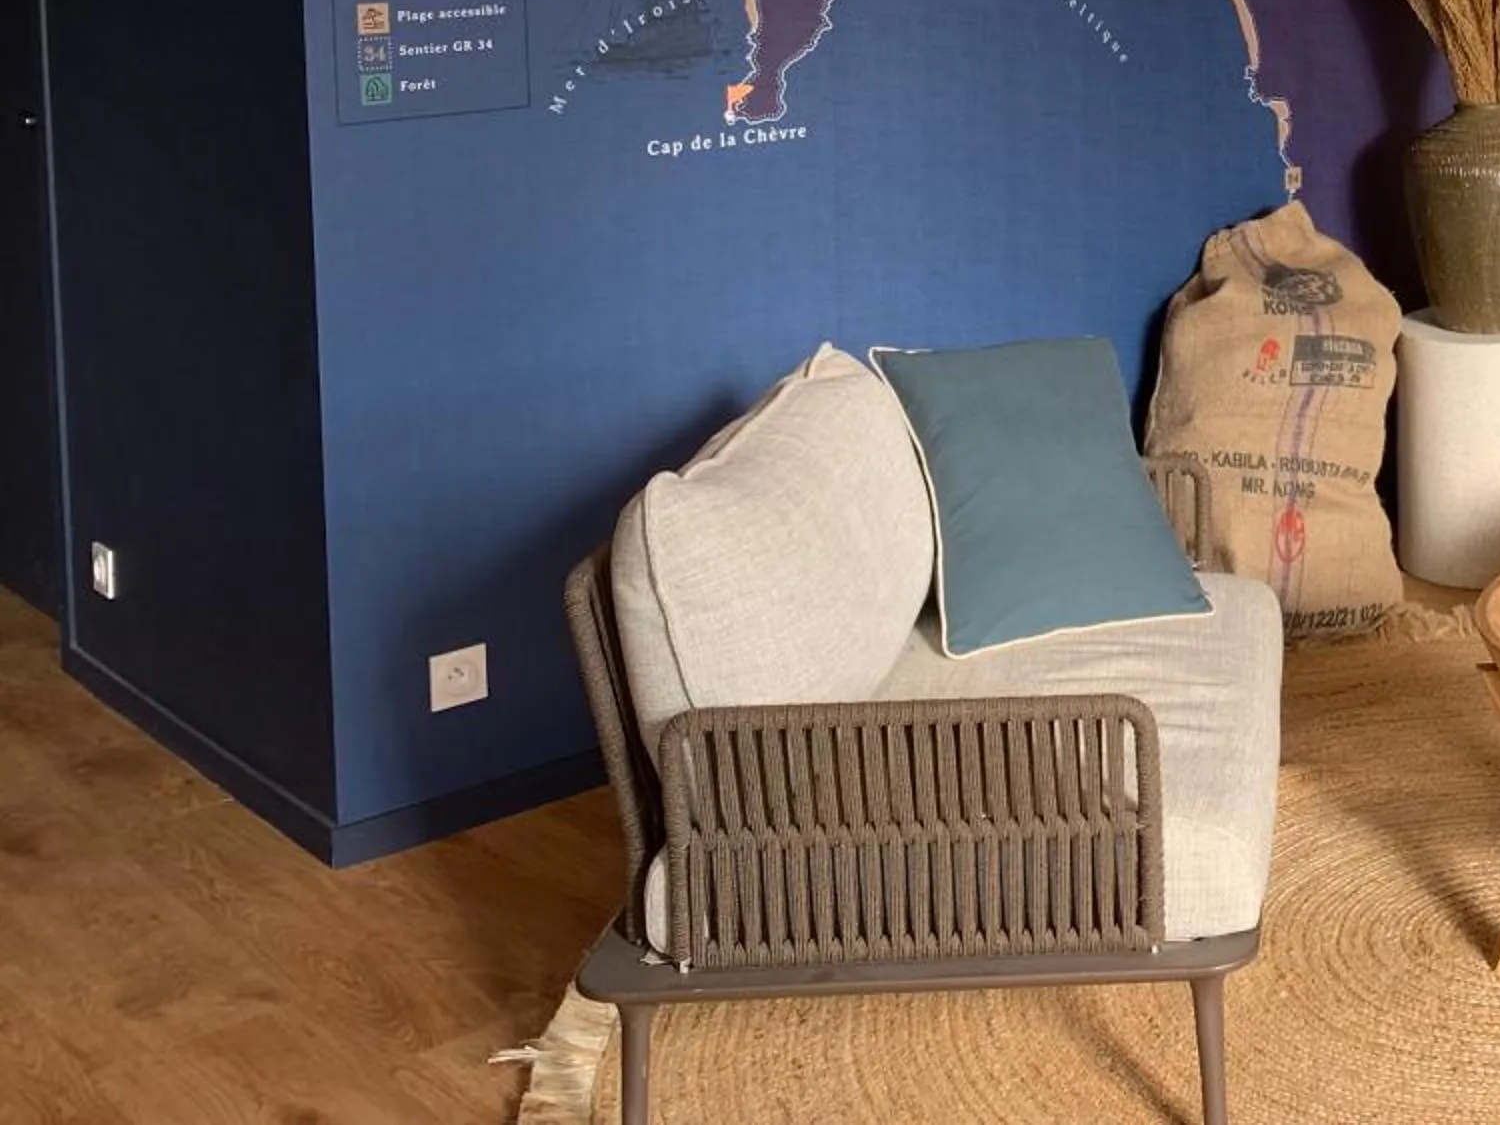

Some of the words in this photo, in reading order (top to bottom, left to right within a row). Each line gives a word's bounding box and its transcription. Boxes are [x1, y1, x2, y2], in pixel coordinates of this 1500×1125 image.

[397, 10, 434, 23] Plage
[437, 3, 507, 20] accessible
[399, 42, 449, 57] Sentier
[453, 39, 473, 53] GR
[477, 38, 493, 50] 34
[400, 78, 436, 92] Forêt
[548, 65, 586, 115] Mer
[647, 140, 683, 157] Cap
[690, 134, 713, 151] de
[719, 132, 737, 148] la
[743, 125, 808, 145] Chèvre
[1211, 451, 1267, 471] KABILA
